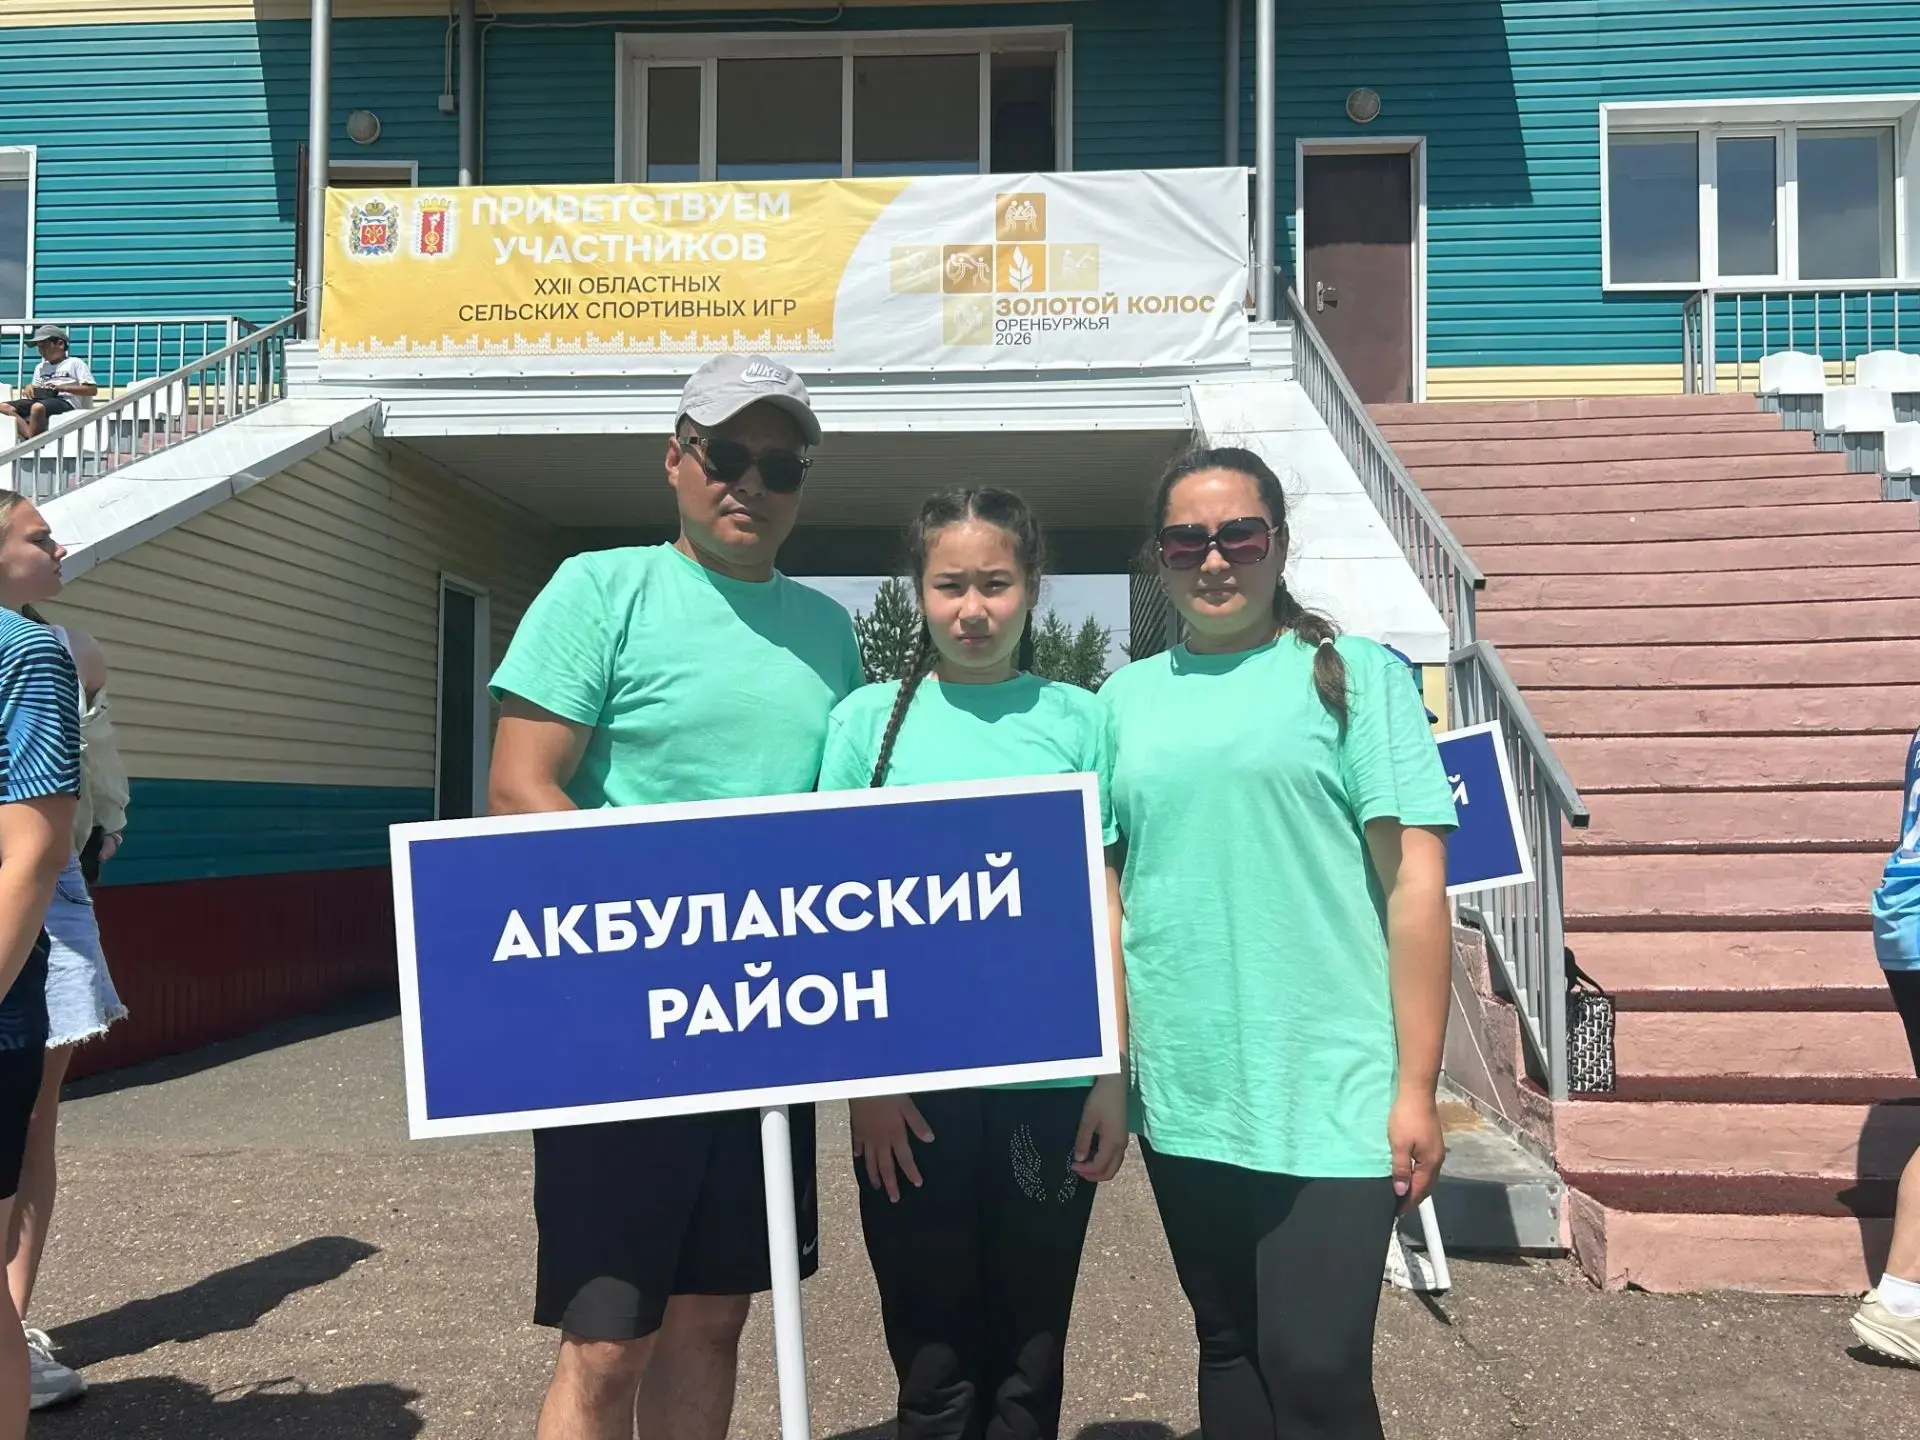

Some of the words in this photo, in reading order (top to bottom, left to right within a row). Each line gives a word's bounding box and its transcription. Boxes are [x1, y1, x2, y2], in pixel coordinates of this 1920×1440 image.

[472, 193, 790, 226] ПРИВЕТСТВУЕМ
[495, 232, 767, 265] УЧАСТНИКОВ
[534, 277, 572, 296] XXII
[578, 275, 721, 295] ОБЛАСТНЫХ
[459, 302, 579, 322] СЕЛЬСКИХ
[586, 300, 746, 321] СПОРТИВНЫХ
[752, 298, 797, 317] ИГР
[996, 291, 1119, 316] ЗОЛОТОЙ
[1128, 295, 1215, 315] КОЛОС
[995, 316, 1110, 333] ОРЕНБУРЖЬЯ
[995, 332, 1032, 346] 2026
[747, 362, 782, 379] NIKE
[492, 851, 1023, 963] АКБУЛАКСКИЙ
[647, 961, 889, 1040] РАЙОН
